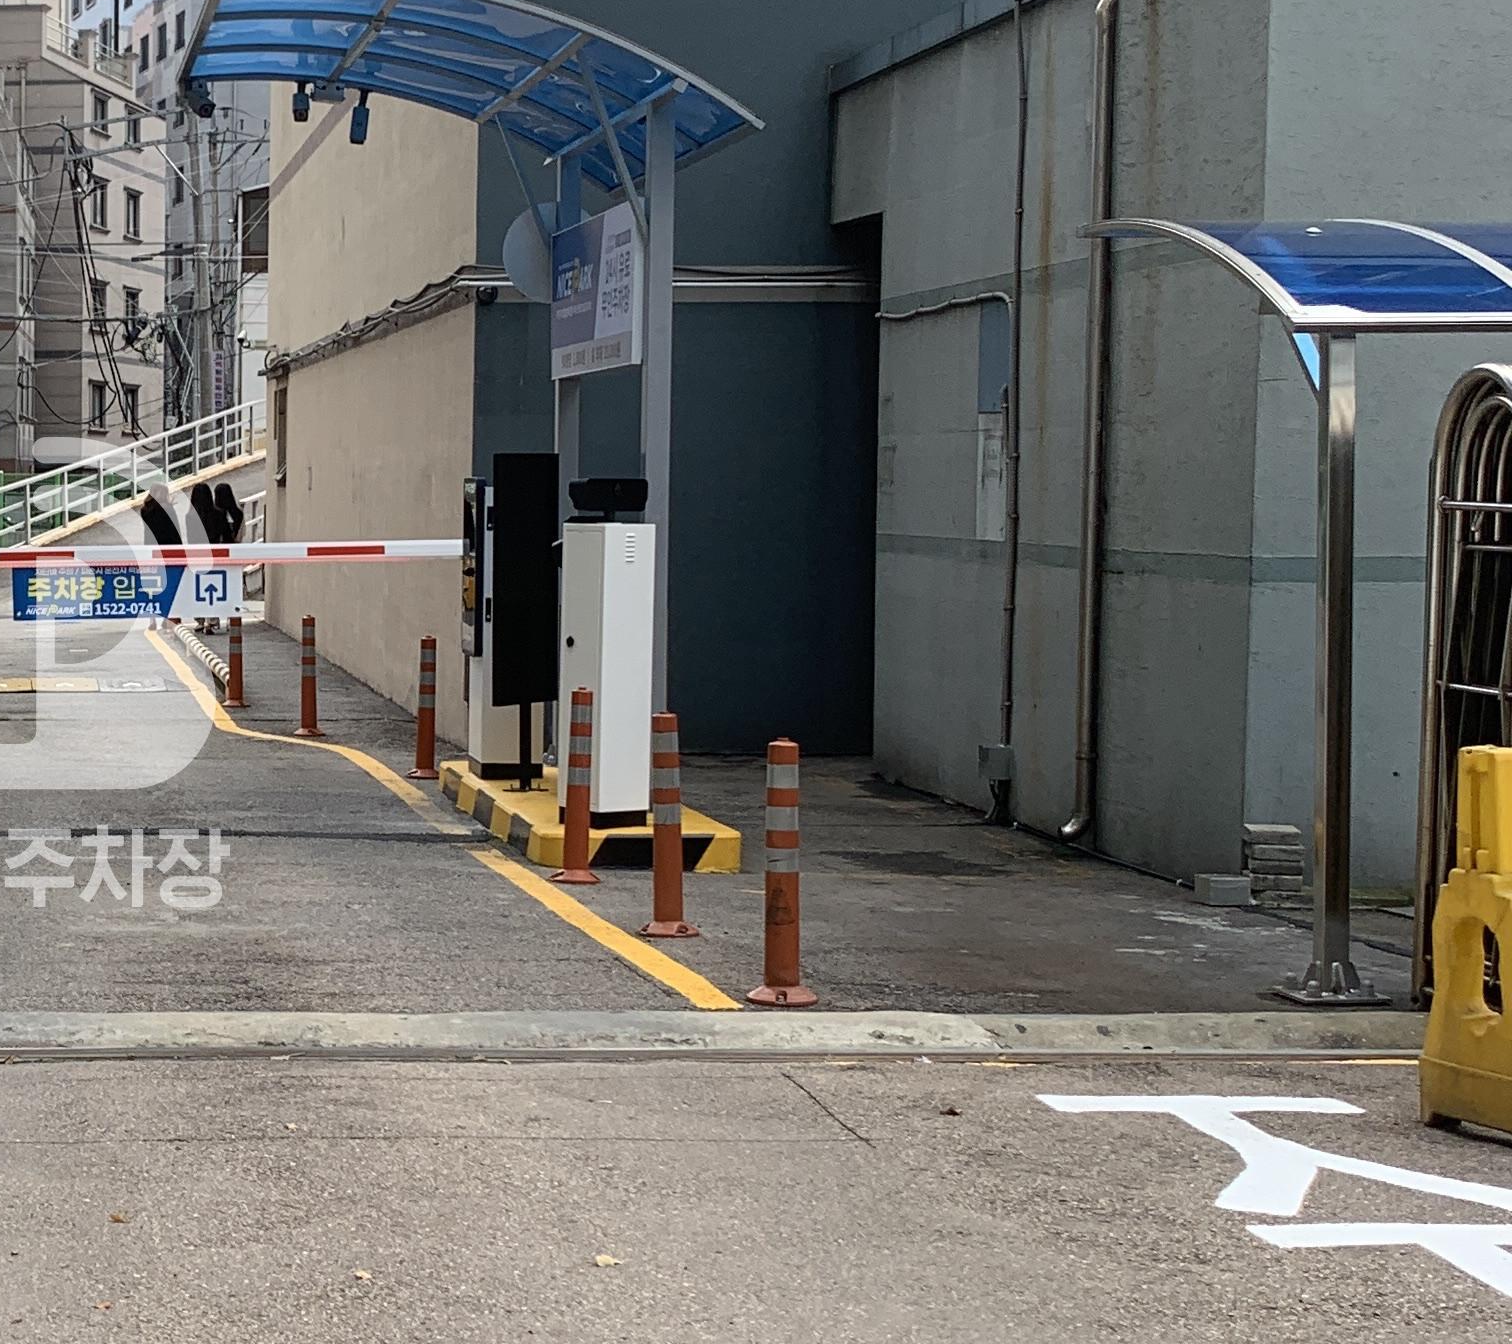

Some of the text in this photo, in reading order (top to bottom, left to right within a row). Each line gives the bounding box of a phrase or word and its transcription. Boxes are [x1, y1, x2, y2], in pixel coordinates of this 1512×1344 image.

[28, 576, 163, 602] 주차장 입구
[25, 602, 162, 616] NICEPARK 1522-0741
